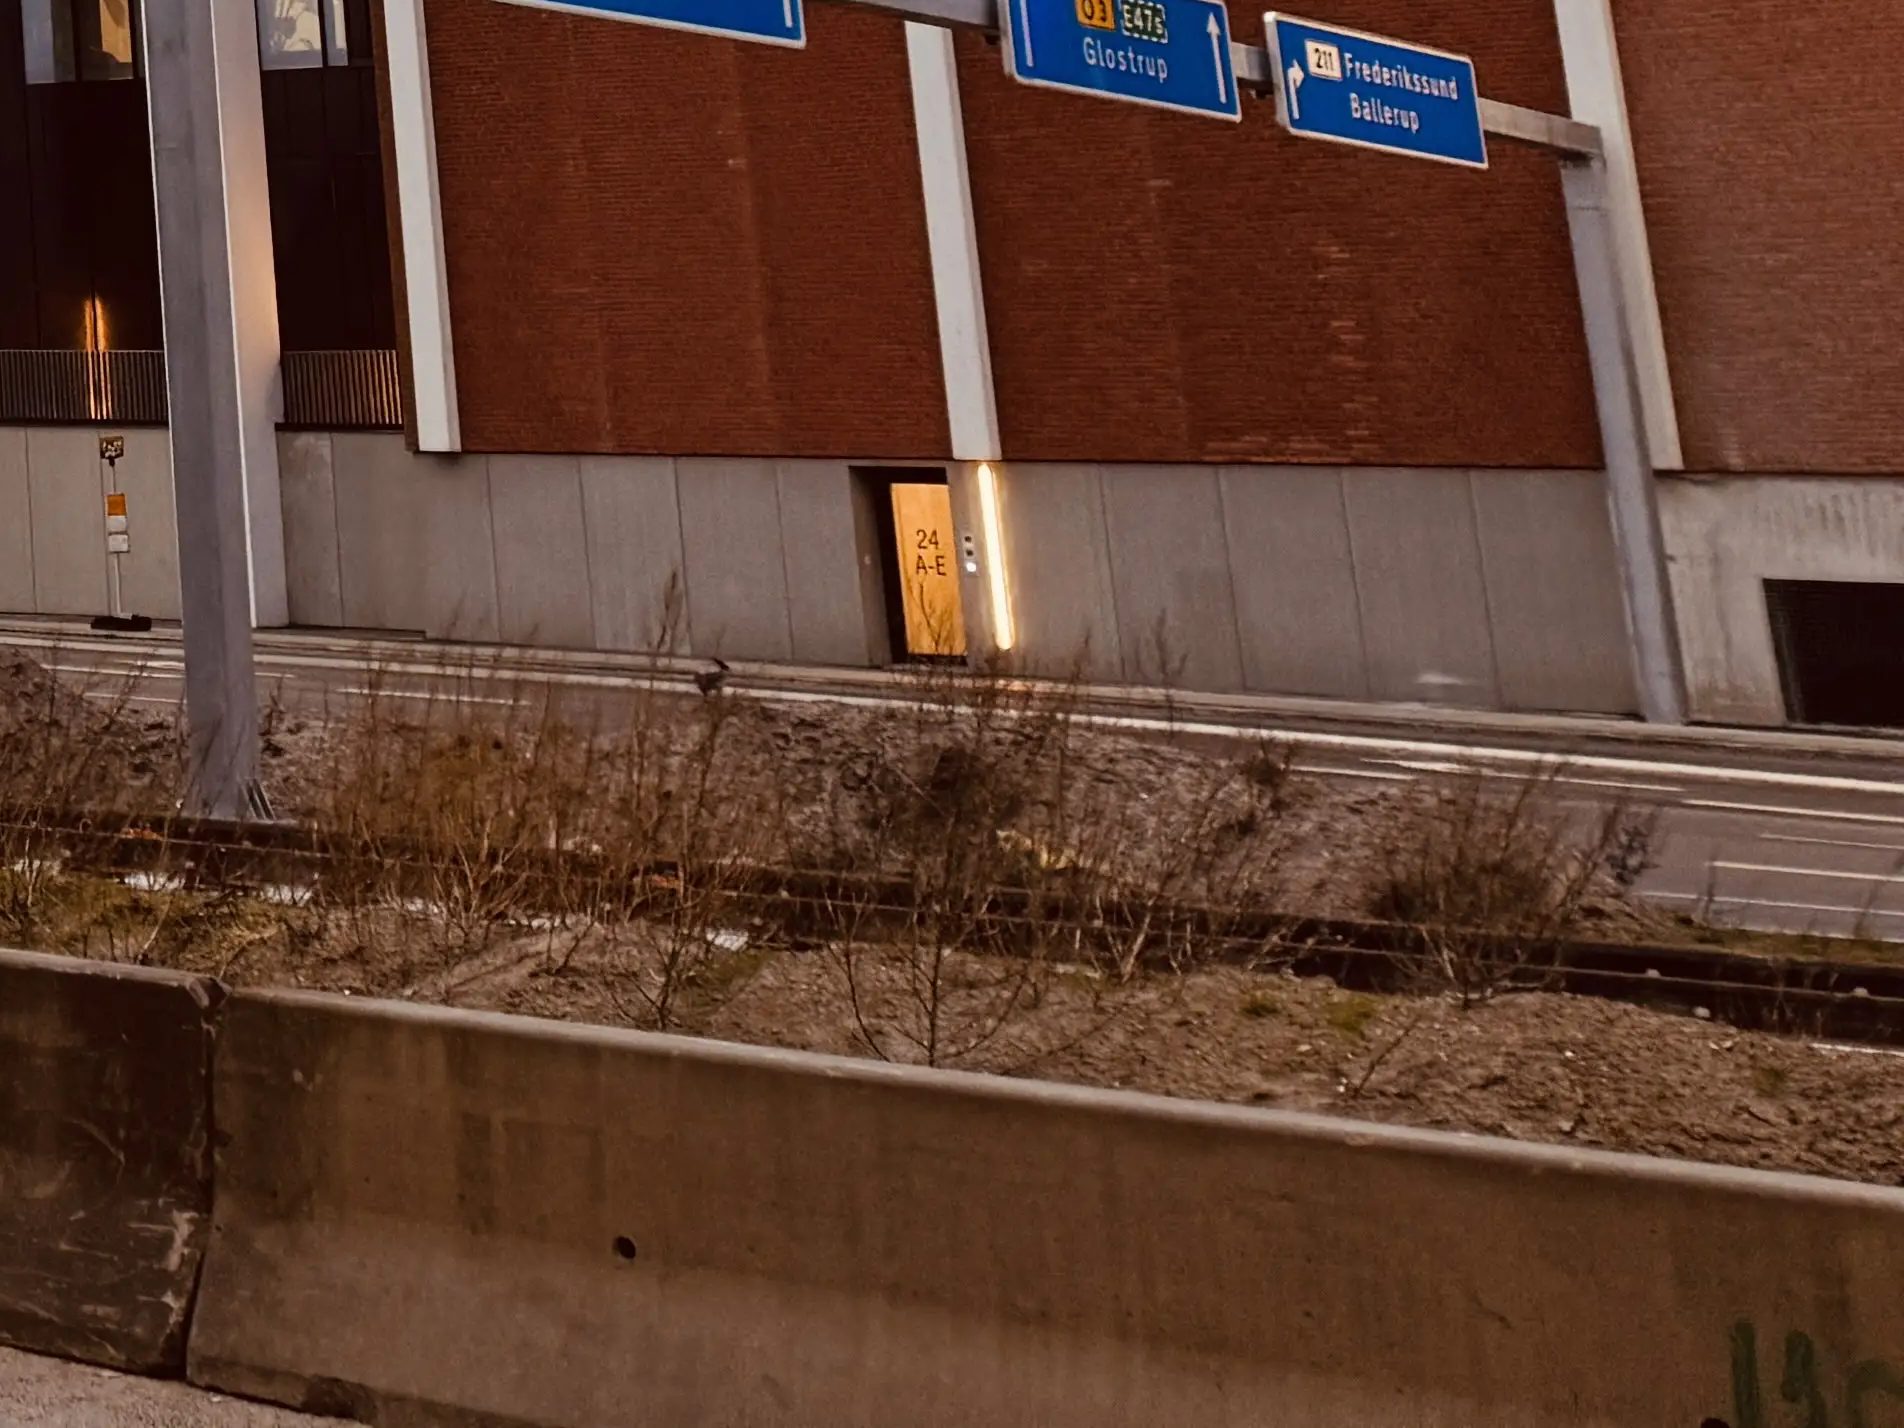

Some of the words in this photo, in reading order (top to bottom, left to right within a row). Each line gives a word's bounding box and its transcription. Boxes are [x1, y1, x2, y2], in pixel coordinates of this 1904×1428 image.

[1083, 36, 1168, 84] Glostrup
[1313, 47, 1335, 72] 211
[1343, 51, 1459, 102] Frederikssund
[1349, 92, 1420, 135] Ballerup
[916, 528, 939, 550] 24
[915, 554, 948, 577] A-E
